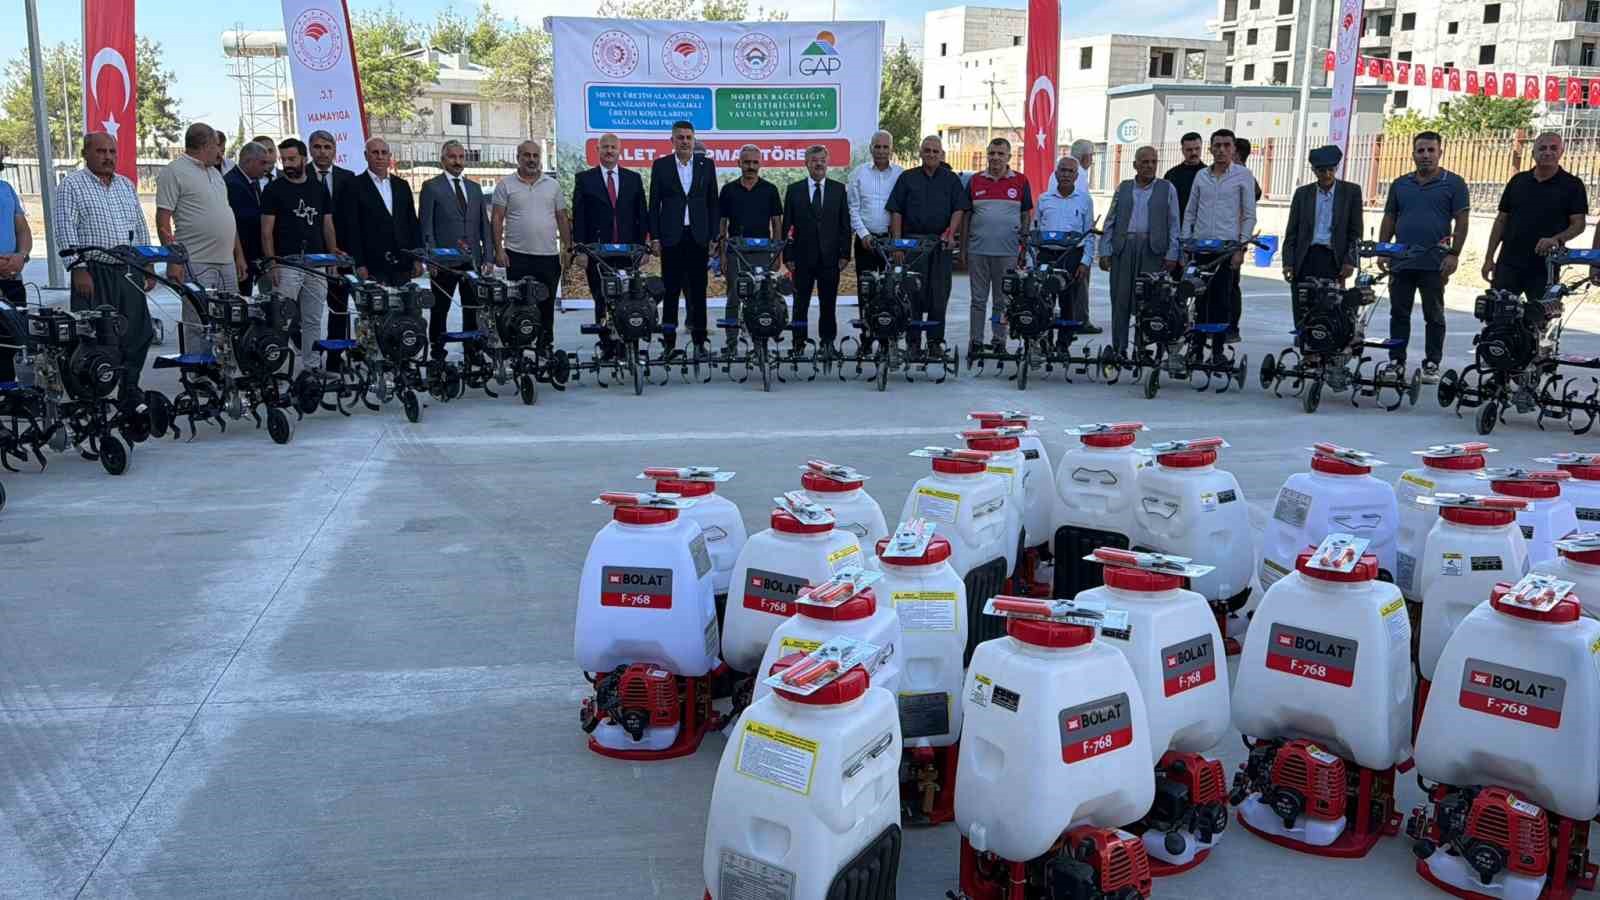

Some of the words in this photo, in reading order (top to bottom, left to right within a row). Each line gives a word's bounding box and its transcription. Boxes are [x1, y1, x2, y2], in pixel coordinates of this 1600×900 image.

[623, 573, 664, 586] BOLAT
[621, 593, 650, 606] F-768
[760, 599, 787, 613] F-768
[1178, 644, 1208, 665] BOLAT
[1295, 635, 1346, 658] BOLAT
[1290, 659, 1326, 678] F-768
[1178, 673, 1201, 688] F-768
[1492, 675, 1547, 699] BOLAT
[1080, 704, 1122, 728] BOLAT
[1487, 697, 1528, 716] F-768
[1082, 735, 1112, 754] F-768
